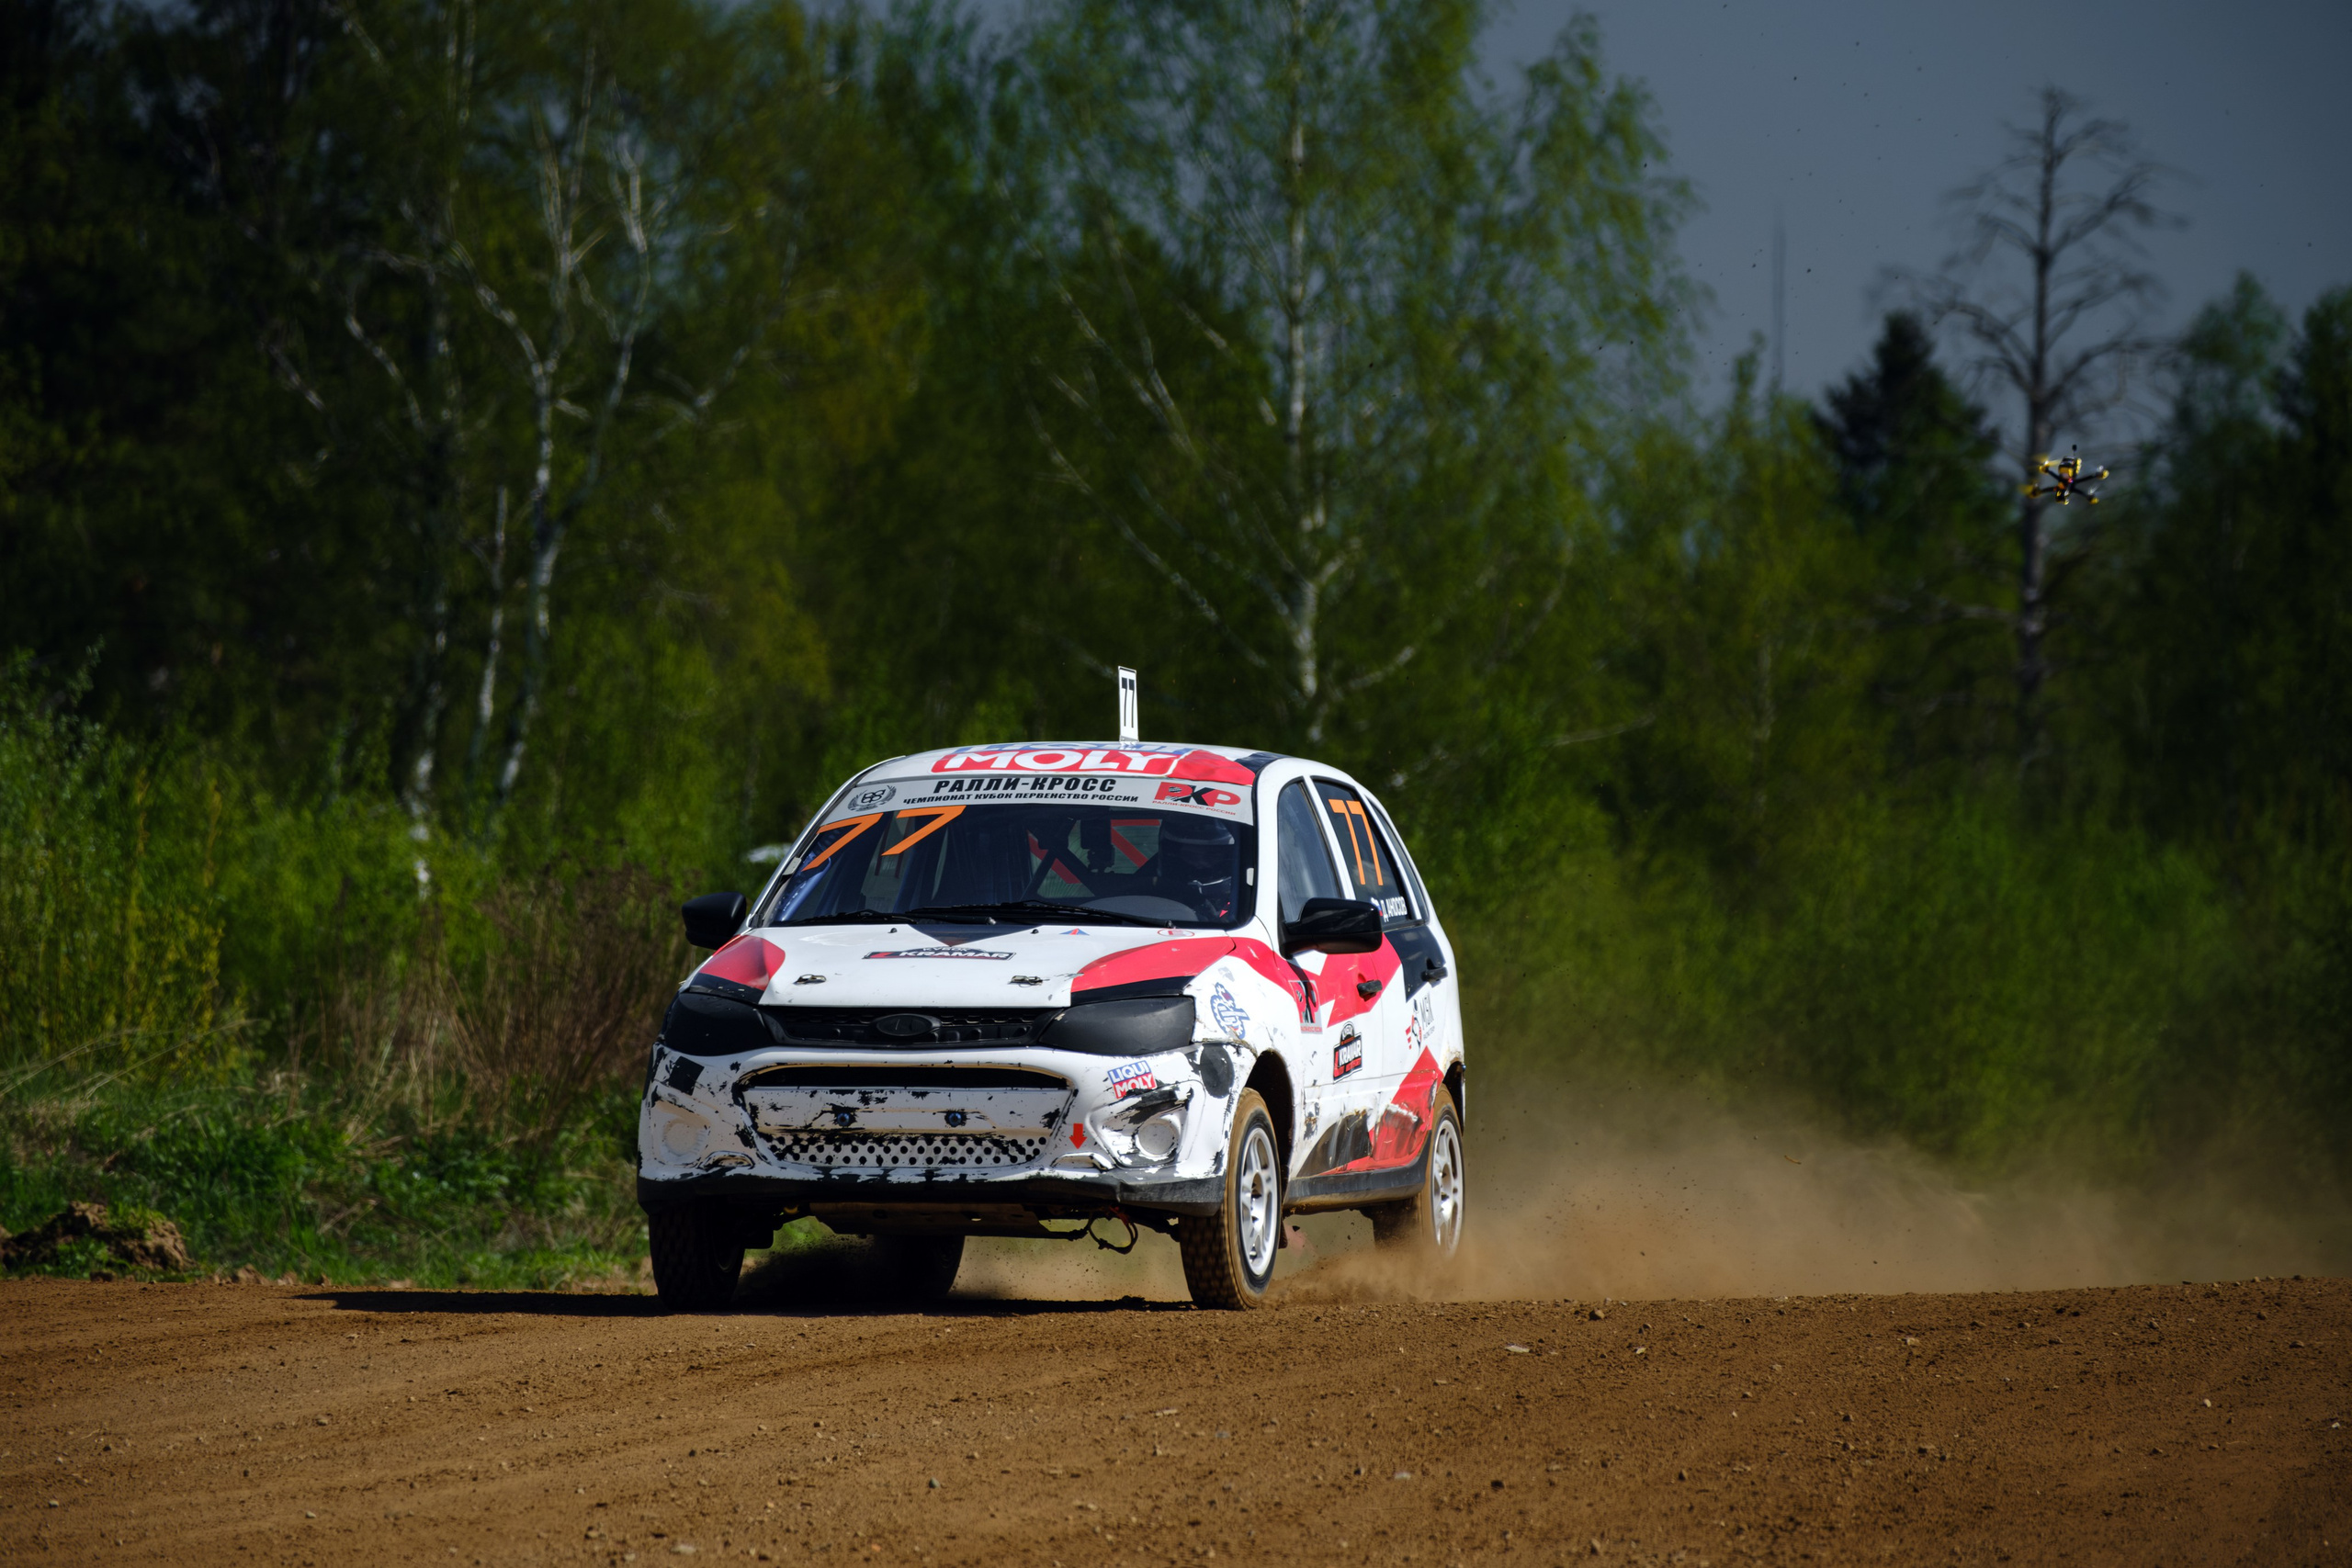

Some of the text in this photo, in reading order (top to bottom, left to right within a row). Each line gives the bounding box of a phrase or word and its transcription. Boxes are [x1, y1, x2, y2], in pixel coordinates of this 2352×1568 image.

[1121, 676, 1136, 728] 77
[944, 750, 1179, 772] MOLY
[933, 776, 1116, 794] РАЛЛИ-КРОСС
[903, 792, 1139, 805] ЧЕМПИОНАТ КУБОК ПЕРВЕНСТВО РОССИИ
[1151, 800, 1237, 816] РАЛЛИ-КРОСС РОССИИ
[801, 805, 967, 872] 77
[1328, 798, 1384, 886] 77
[899, 951, 1011, 960] KRAMAR
[1109, 1062, 1151, 1084] LIQUI
[1114, 1074, 1153, 1098] MOLY
